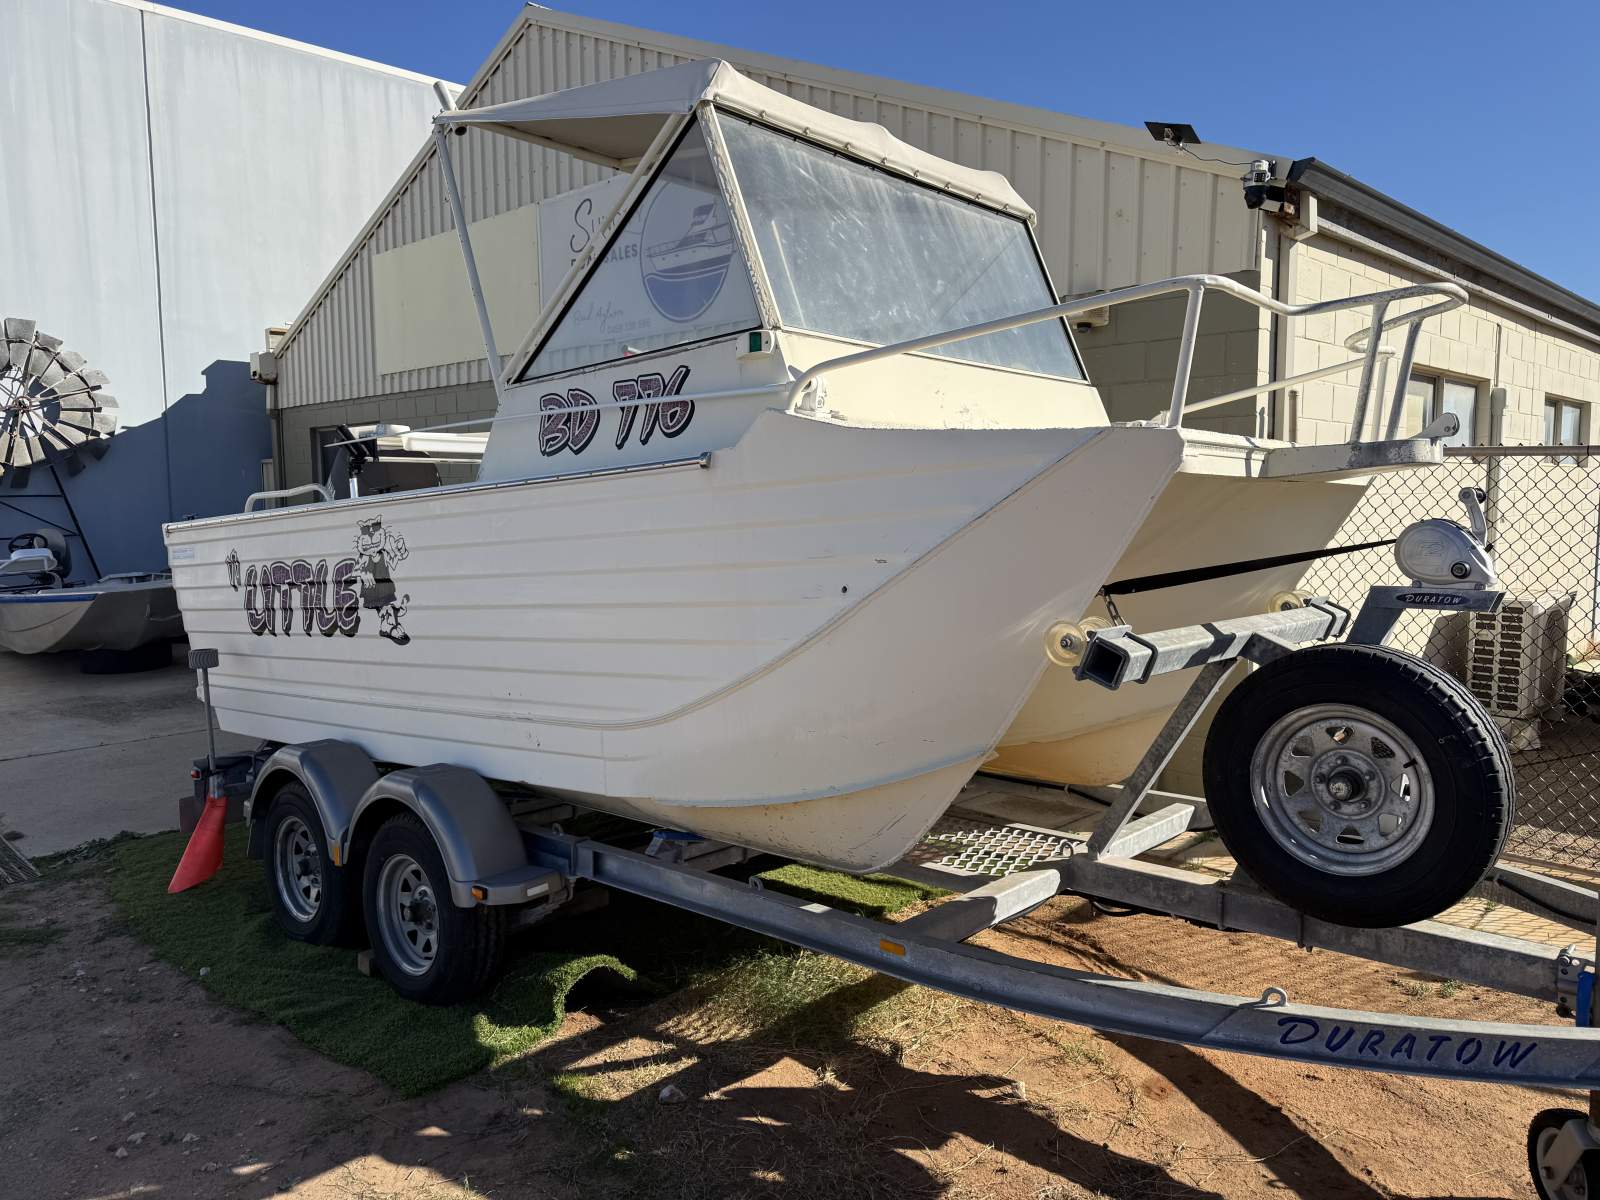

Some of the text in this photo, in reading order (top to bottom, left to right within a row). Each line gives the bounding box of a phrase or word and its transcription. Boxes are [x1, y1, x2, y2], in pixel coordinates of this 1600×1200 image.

[612, 364, 696, 450] 776
[243, 557, 361, 638] LITTLE
[1405, 593, 1463, 605] DURATOW
[1277, 1016, 1538, 1070] DURATOW
